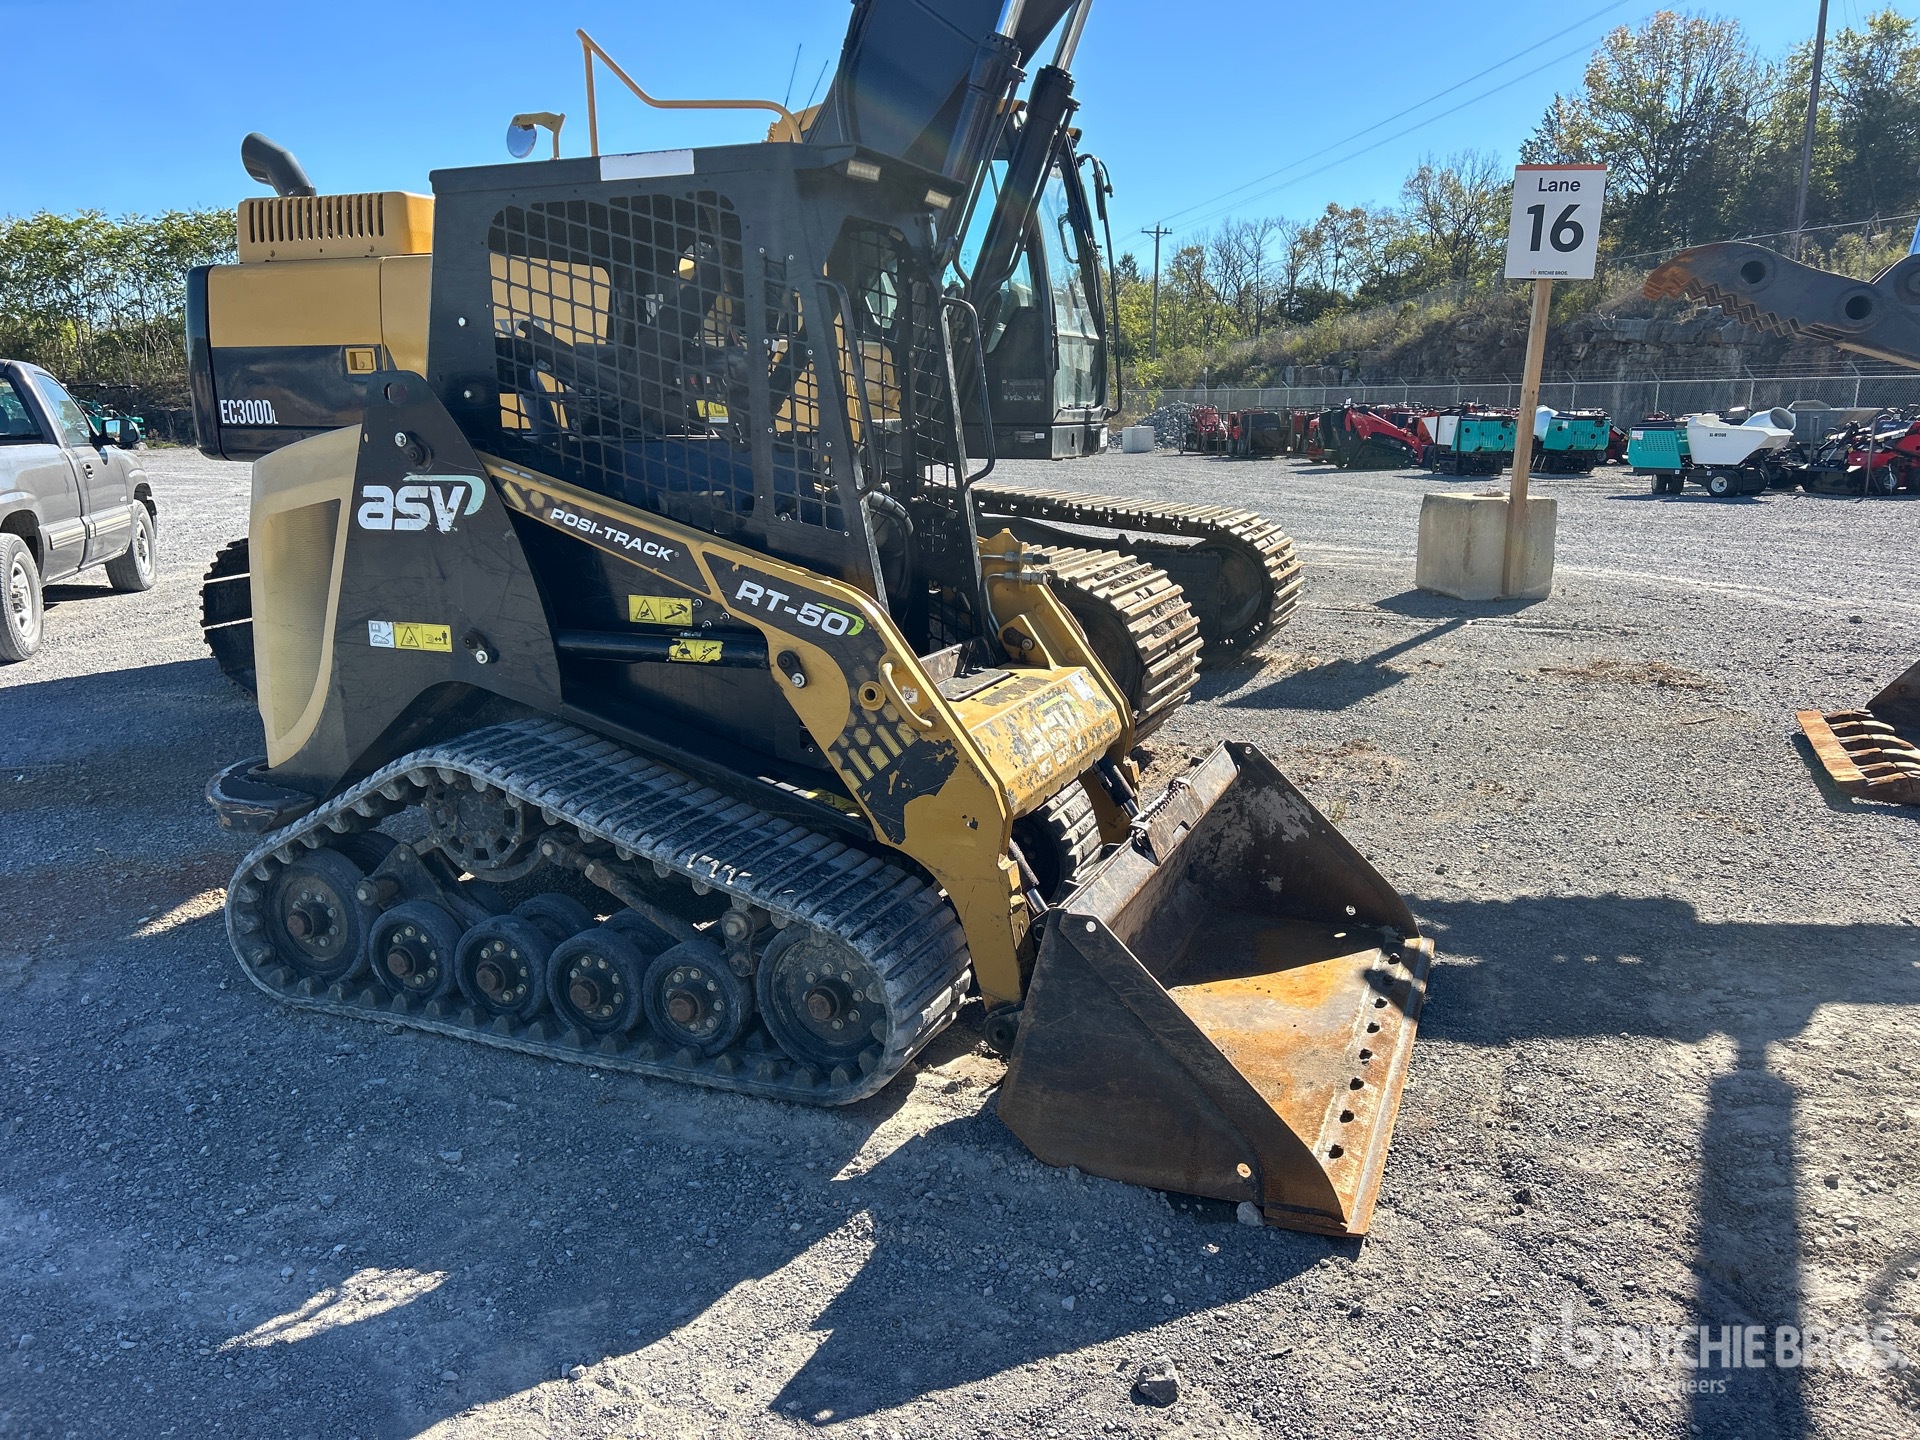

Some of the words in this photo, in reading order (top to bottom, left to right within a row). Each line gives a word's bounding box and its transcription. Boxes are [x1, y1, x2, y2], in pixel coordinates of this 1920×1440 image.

[1537, 177, 1581, 192] Lane
[1526, 203, 1584, 253] 16
[735, 579, 850, 636] RT-50
